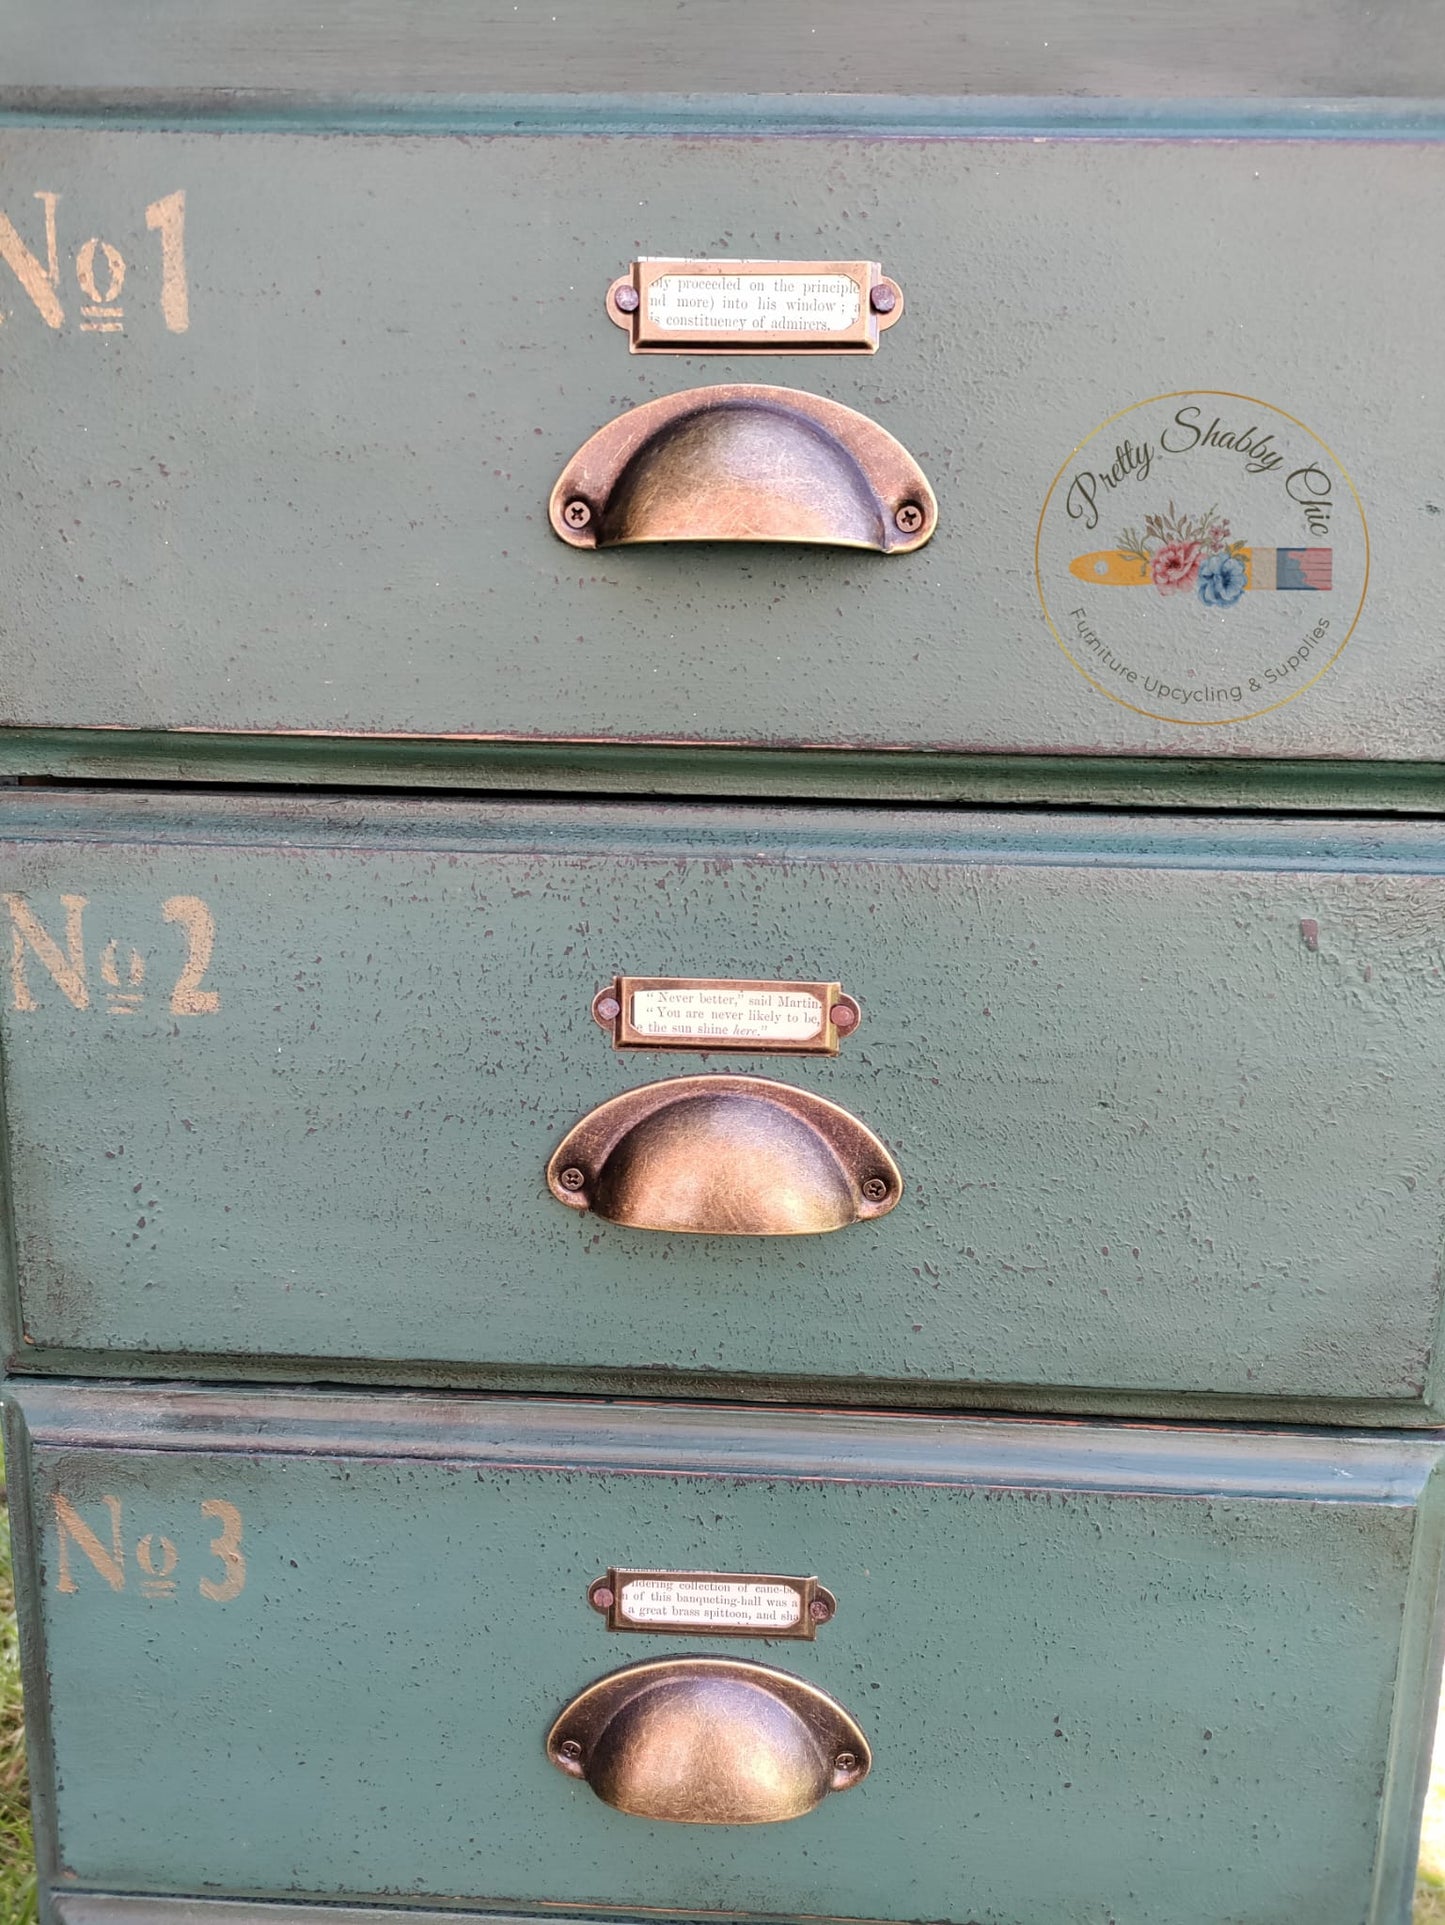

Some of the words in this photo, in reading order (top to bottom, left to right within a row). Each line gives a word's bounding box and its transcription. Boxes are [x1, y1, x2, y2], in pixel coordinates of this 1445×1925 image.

[145, 190, 190, 333] 1
[678, 277, 741, 292] proceeded
[749, 282, 765, 291] on
[774, 279, 795, 292] the
[650, 294, 666, 306] nd
[677, 296, 714, 311] more)
[723, 296, 748, 309] into
[758, 297, 777, 310] his
[666, 314, 747, 330] constituency
[752, 316, 766, 329] of
[771, 316, 831, 331] admirers.
[162, 895, 220, 1016] 2
[749, 995, 772, 1006] said
[711, 1012, 744, 1021] never
[749, 1010, 781, 1025] likely
[787, 1014, 799, 1023] to
[648, 1021, 667, 1032] the
[672, 1026, 692, 1034] sun
[697, 1023, 729, 1035] shine
[200, 1499, 246, 1602] 3
[679, 1581, 730, 1592] collection
[738, 1584, 749, 1592] of
[633, 1591, 645, 1600] of
[651, 1592, 671, 1602] this
[676, 1592, 761, 1606] banqueting-hall
[639, 1606, 667, 1616] great
[672, 1606, 700, 1616] brass
[704, 1607, 752, 1620] spittoon,
[756, 1610, 776, 1620] and
